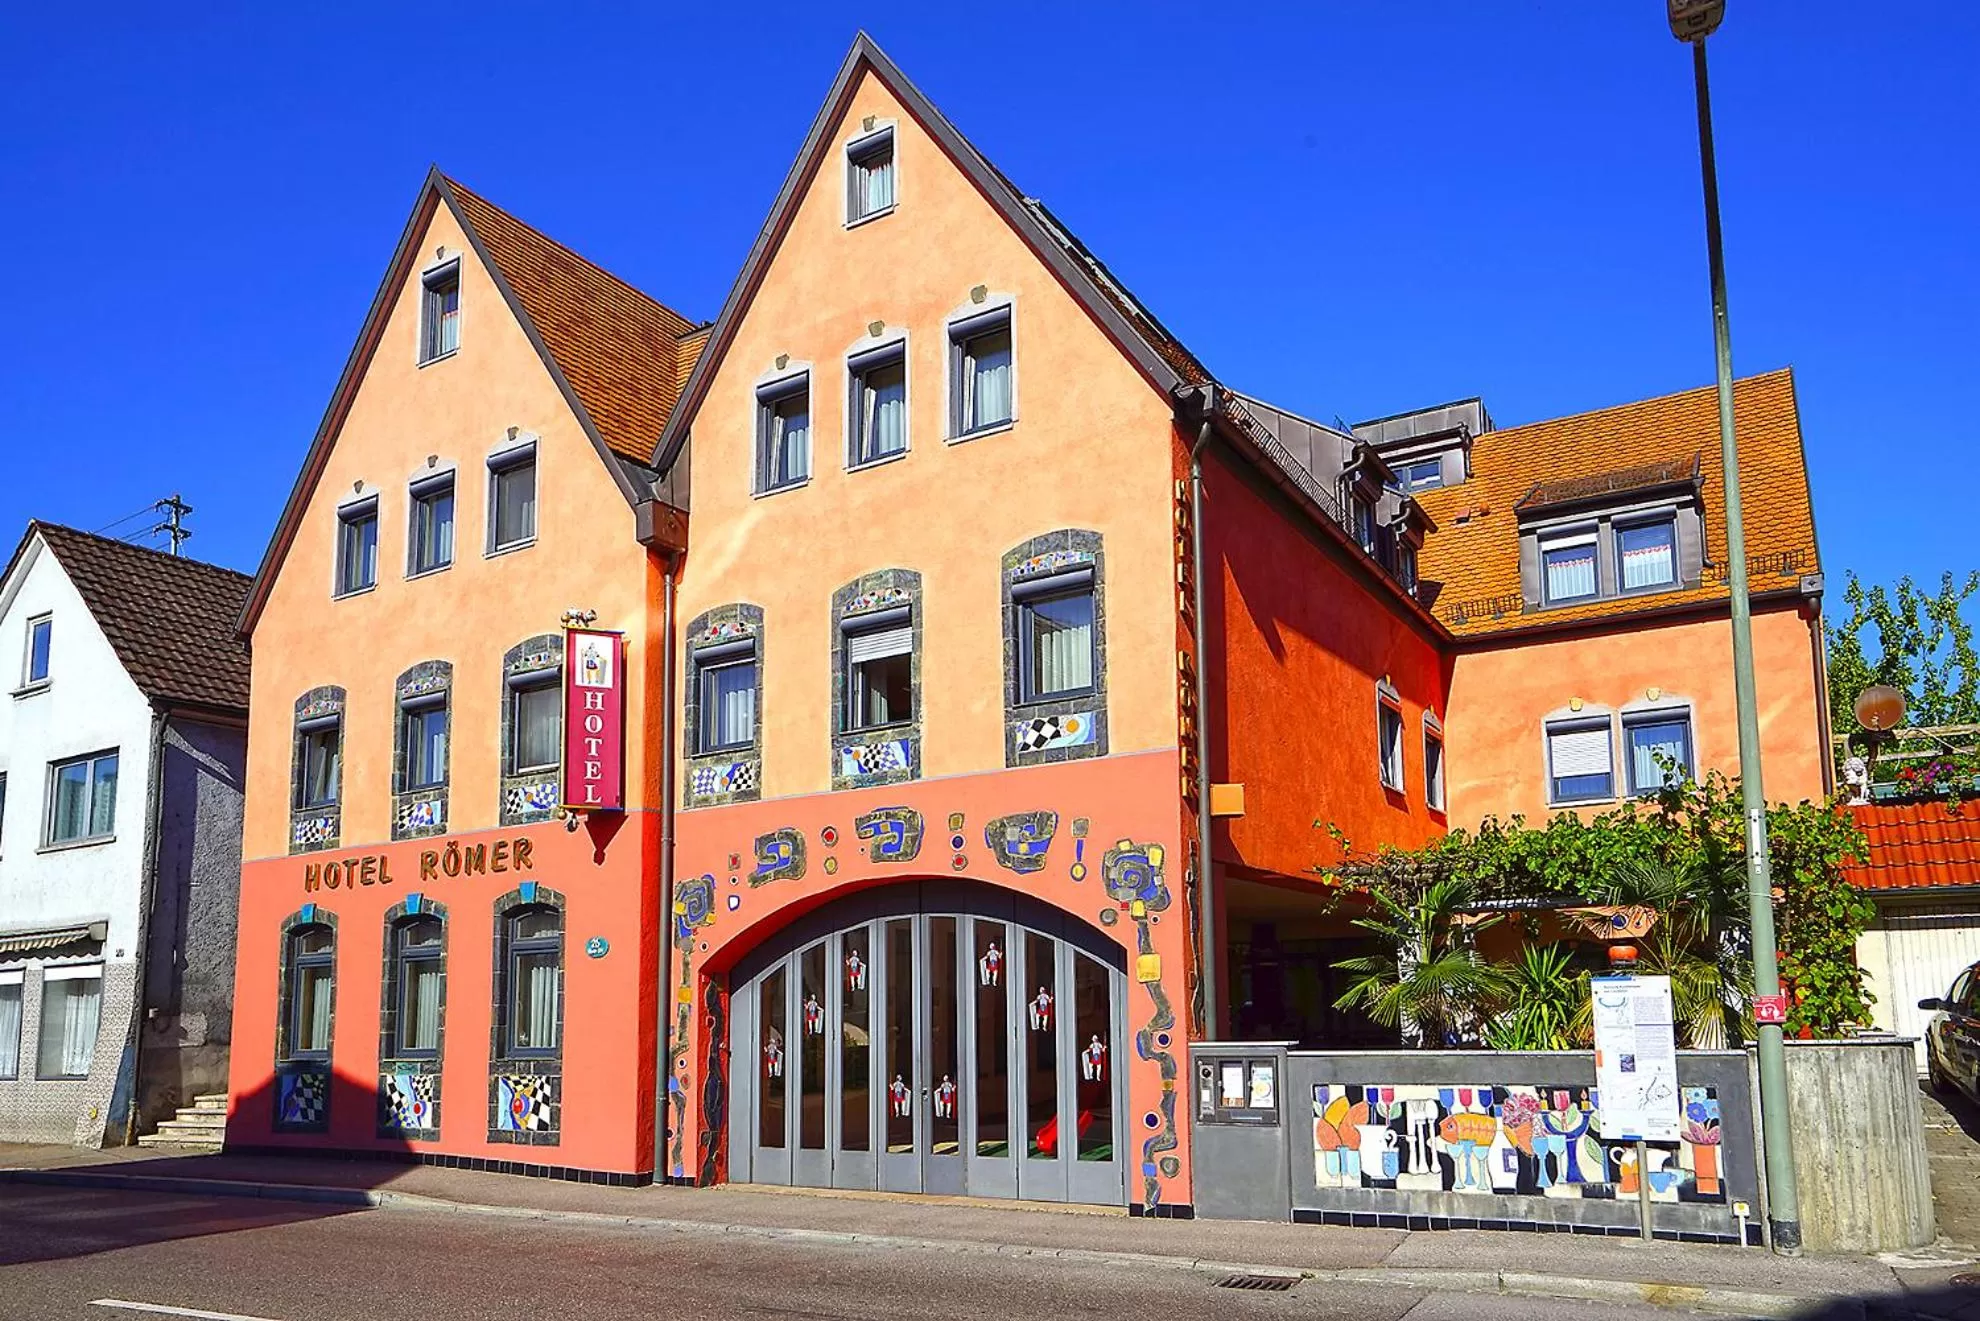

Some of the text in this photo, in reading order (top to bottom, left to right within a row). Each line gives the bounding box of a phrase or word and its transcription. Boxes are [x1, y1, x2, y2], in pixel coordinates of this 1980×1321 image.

[583, 691, 605, 803] HOTEL
[305, 837, 534, 893] HOTEL RÖMER
